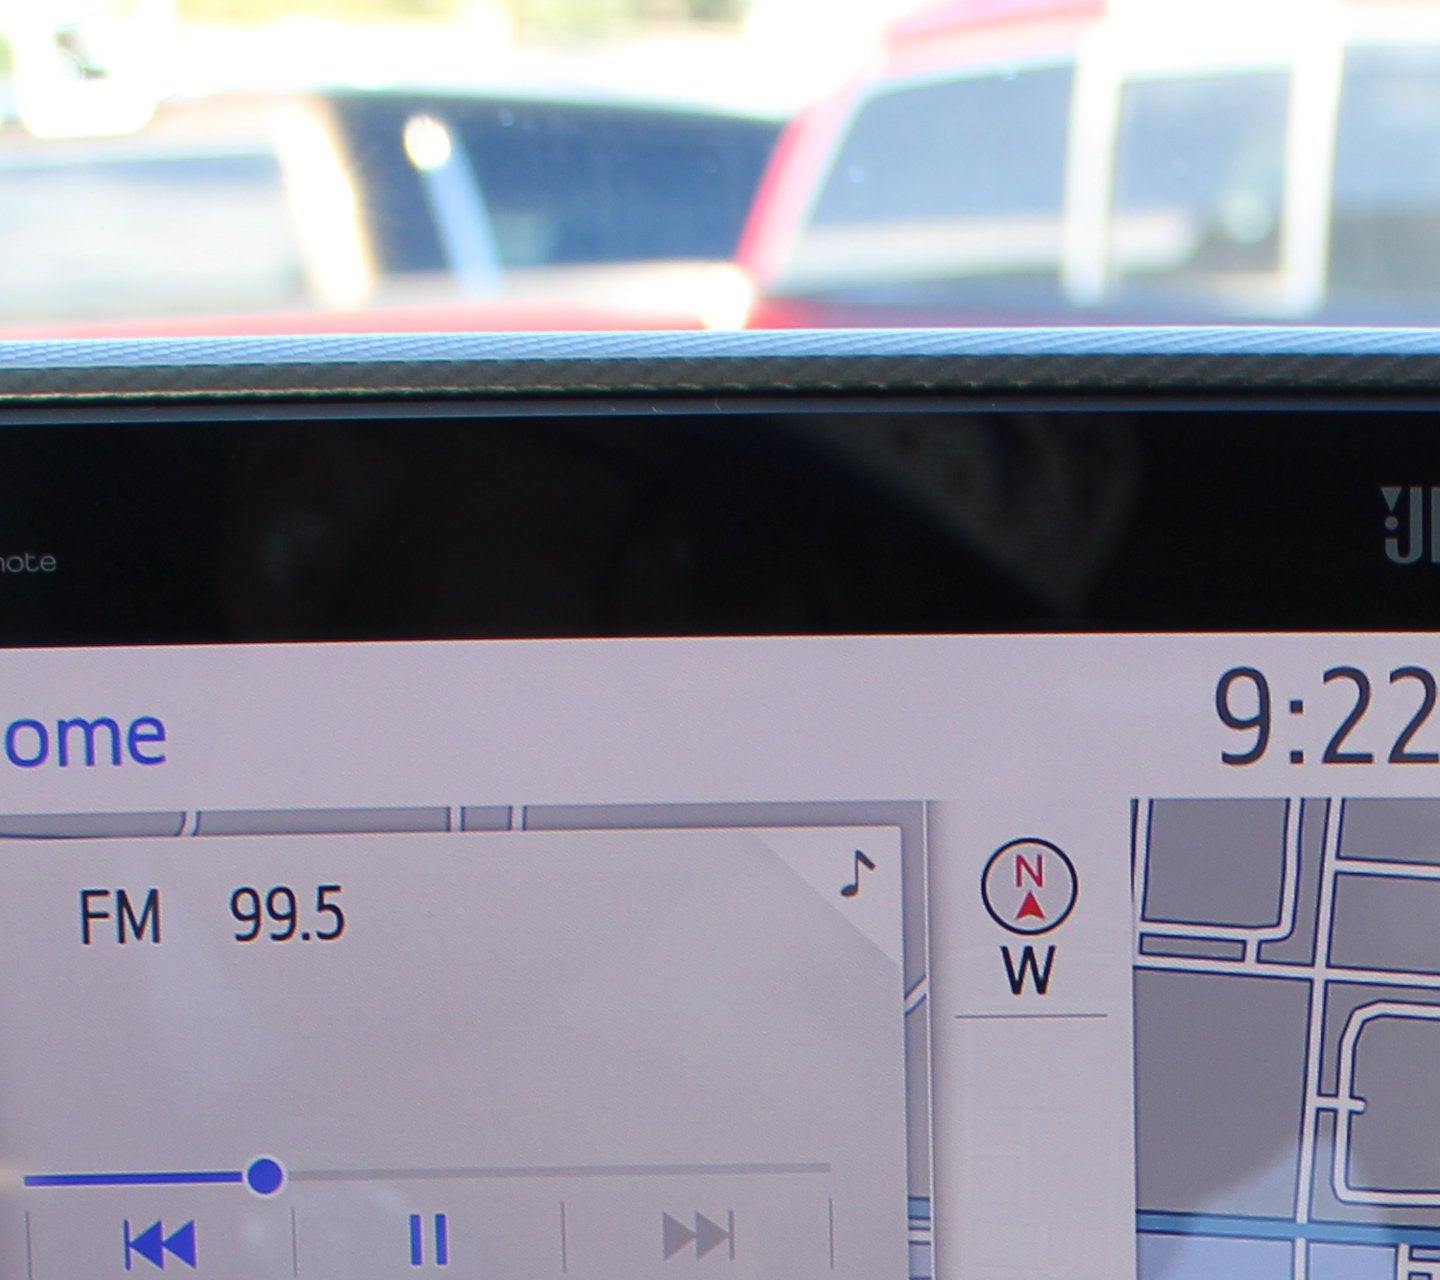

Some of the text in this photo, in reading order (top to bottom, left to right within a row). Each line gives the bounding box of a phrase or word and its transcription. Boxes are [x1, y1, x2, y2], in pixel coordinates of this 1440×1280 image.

[1215, 666, 1440, 765] 9:22
[1014, 853, 1044, 887] N
[79, 884, 346, 944] FM 99.5
[1001, 944, 1056, 996] W
